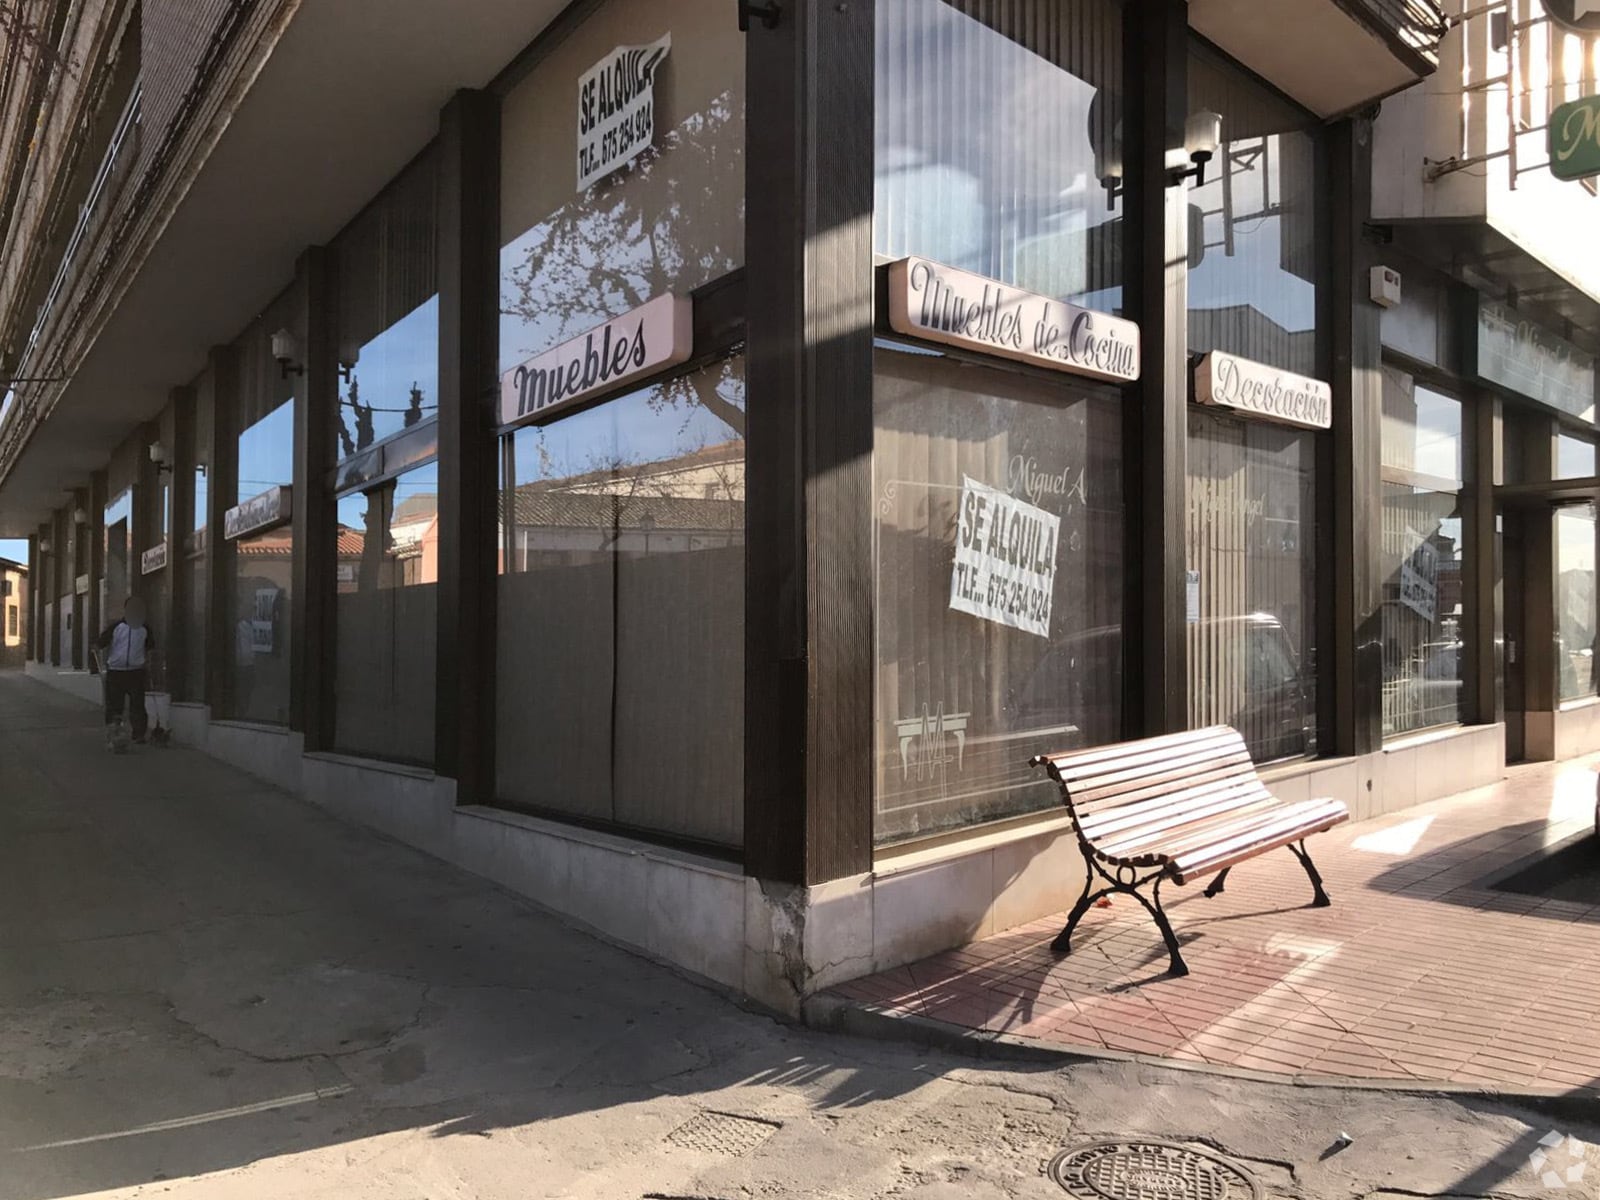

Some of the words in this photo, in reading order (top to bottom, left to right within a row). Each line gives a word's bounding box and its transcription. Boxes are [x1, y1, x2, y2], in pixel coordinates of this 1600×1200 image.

[581, 78, 595, 135] SE
[602, 128, 617, 165] 675
[619, 114, 634, 155] 254
[636, 101, 651, 142] 924
[911, 261, 1023, 349] Muebles
[1033, 302, 1060, 358] de
[1063, 311, 1136, 376] Cocina
[514, 317, 646, 416] Muebles
[1007, 455, 1070, 506] Miguel
[962, 490, 986, 553] SE
[987, 503, 1054, 578] ALQUILA
[987, 573, 1009, 611] 675
[1008, 581, 1028, 618] 254
[1030, 590, 1049, 622] 924
